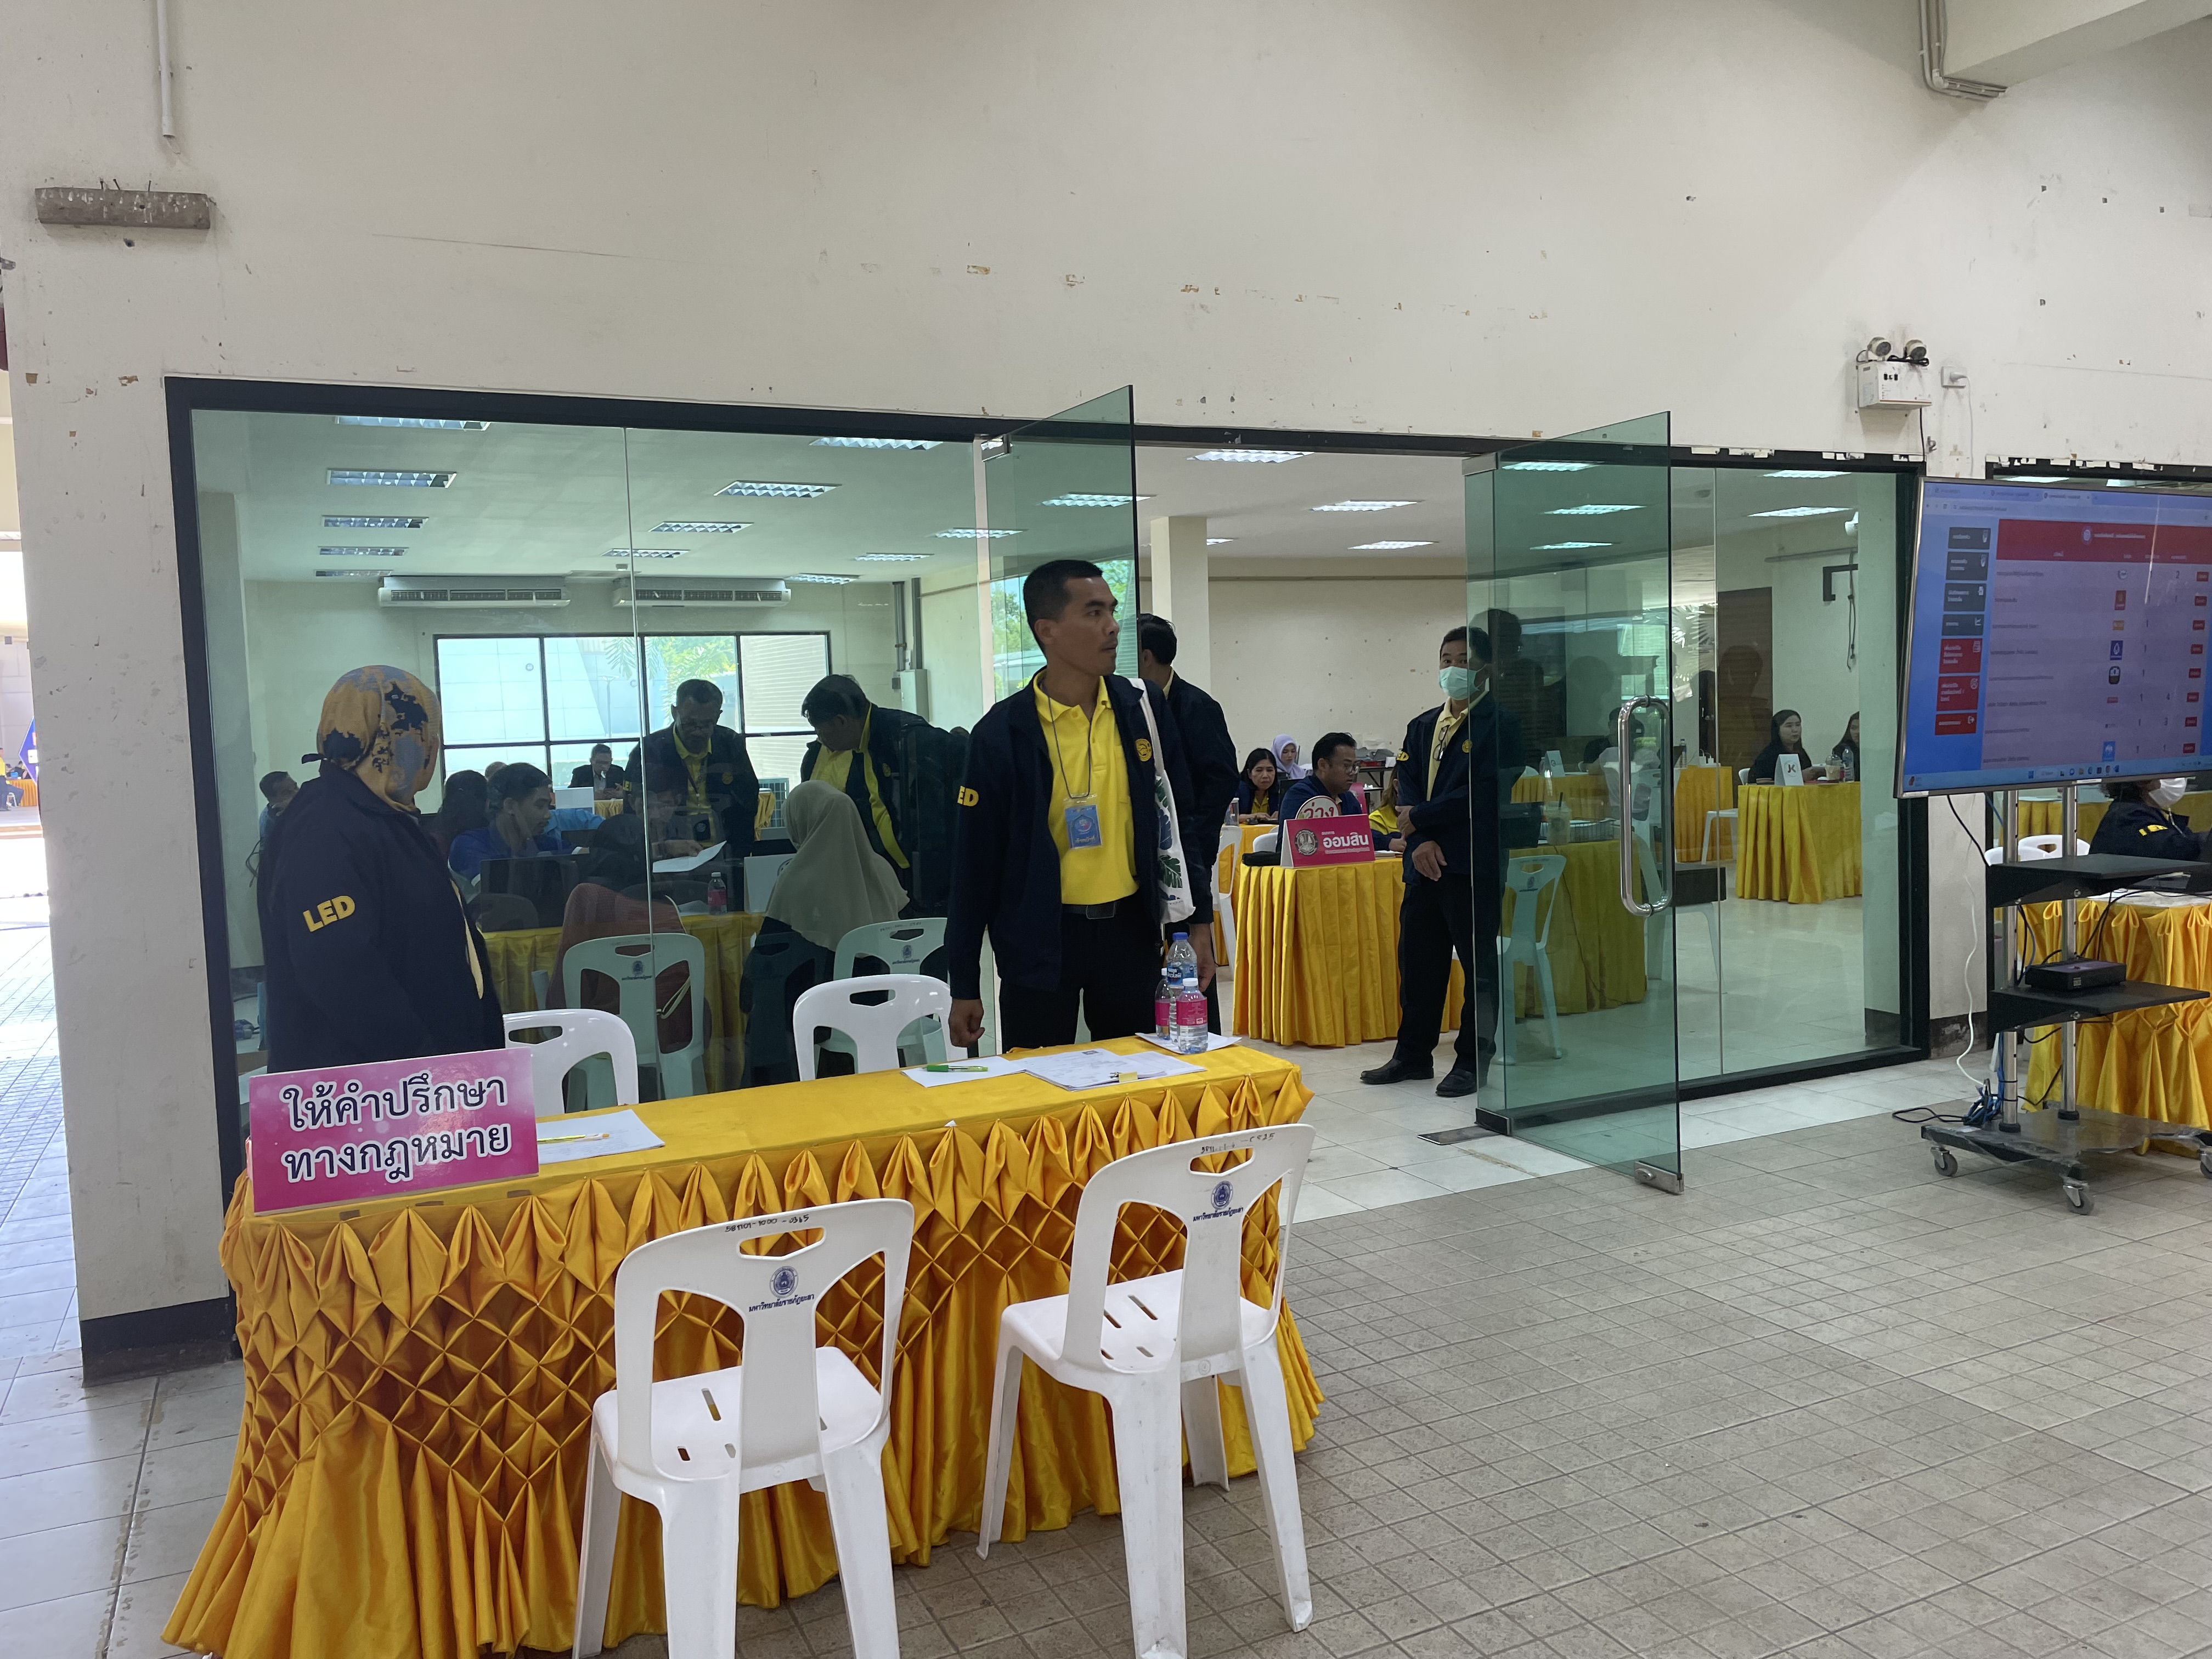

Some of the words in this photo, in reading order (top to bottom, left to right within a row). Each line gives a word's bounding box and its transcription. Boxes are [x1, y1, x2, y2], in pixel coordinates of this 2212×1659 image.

[957, 785, 979, 807] ED
[1323, 832, 1369, 849] ออมสิน
[303, 895, 356, 932] LED
[283, 1071, 505, 1128] ให้คำปรึกษา
[284, 1124, 510, 1181] ทางกฎหมาย
